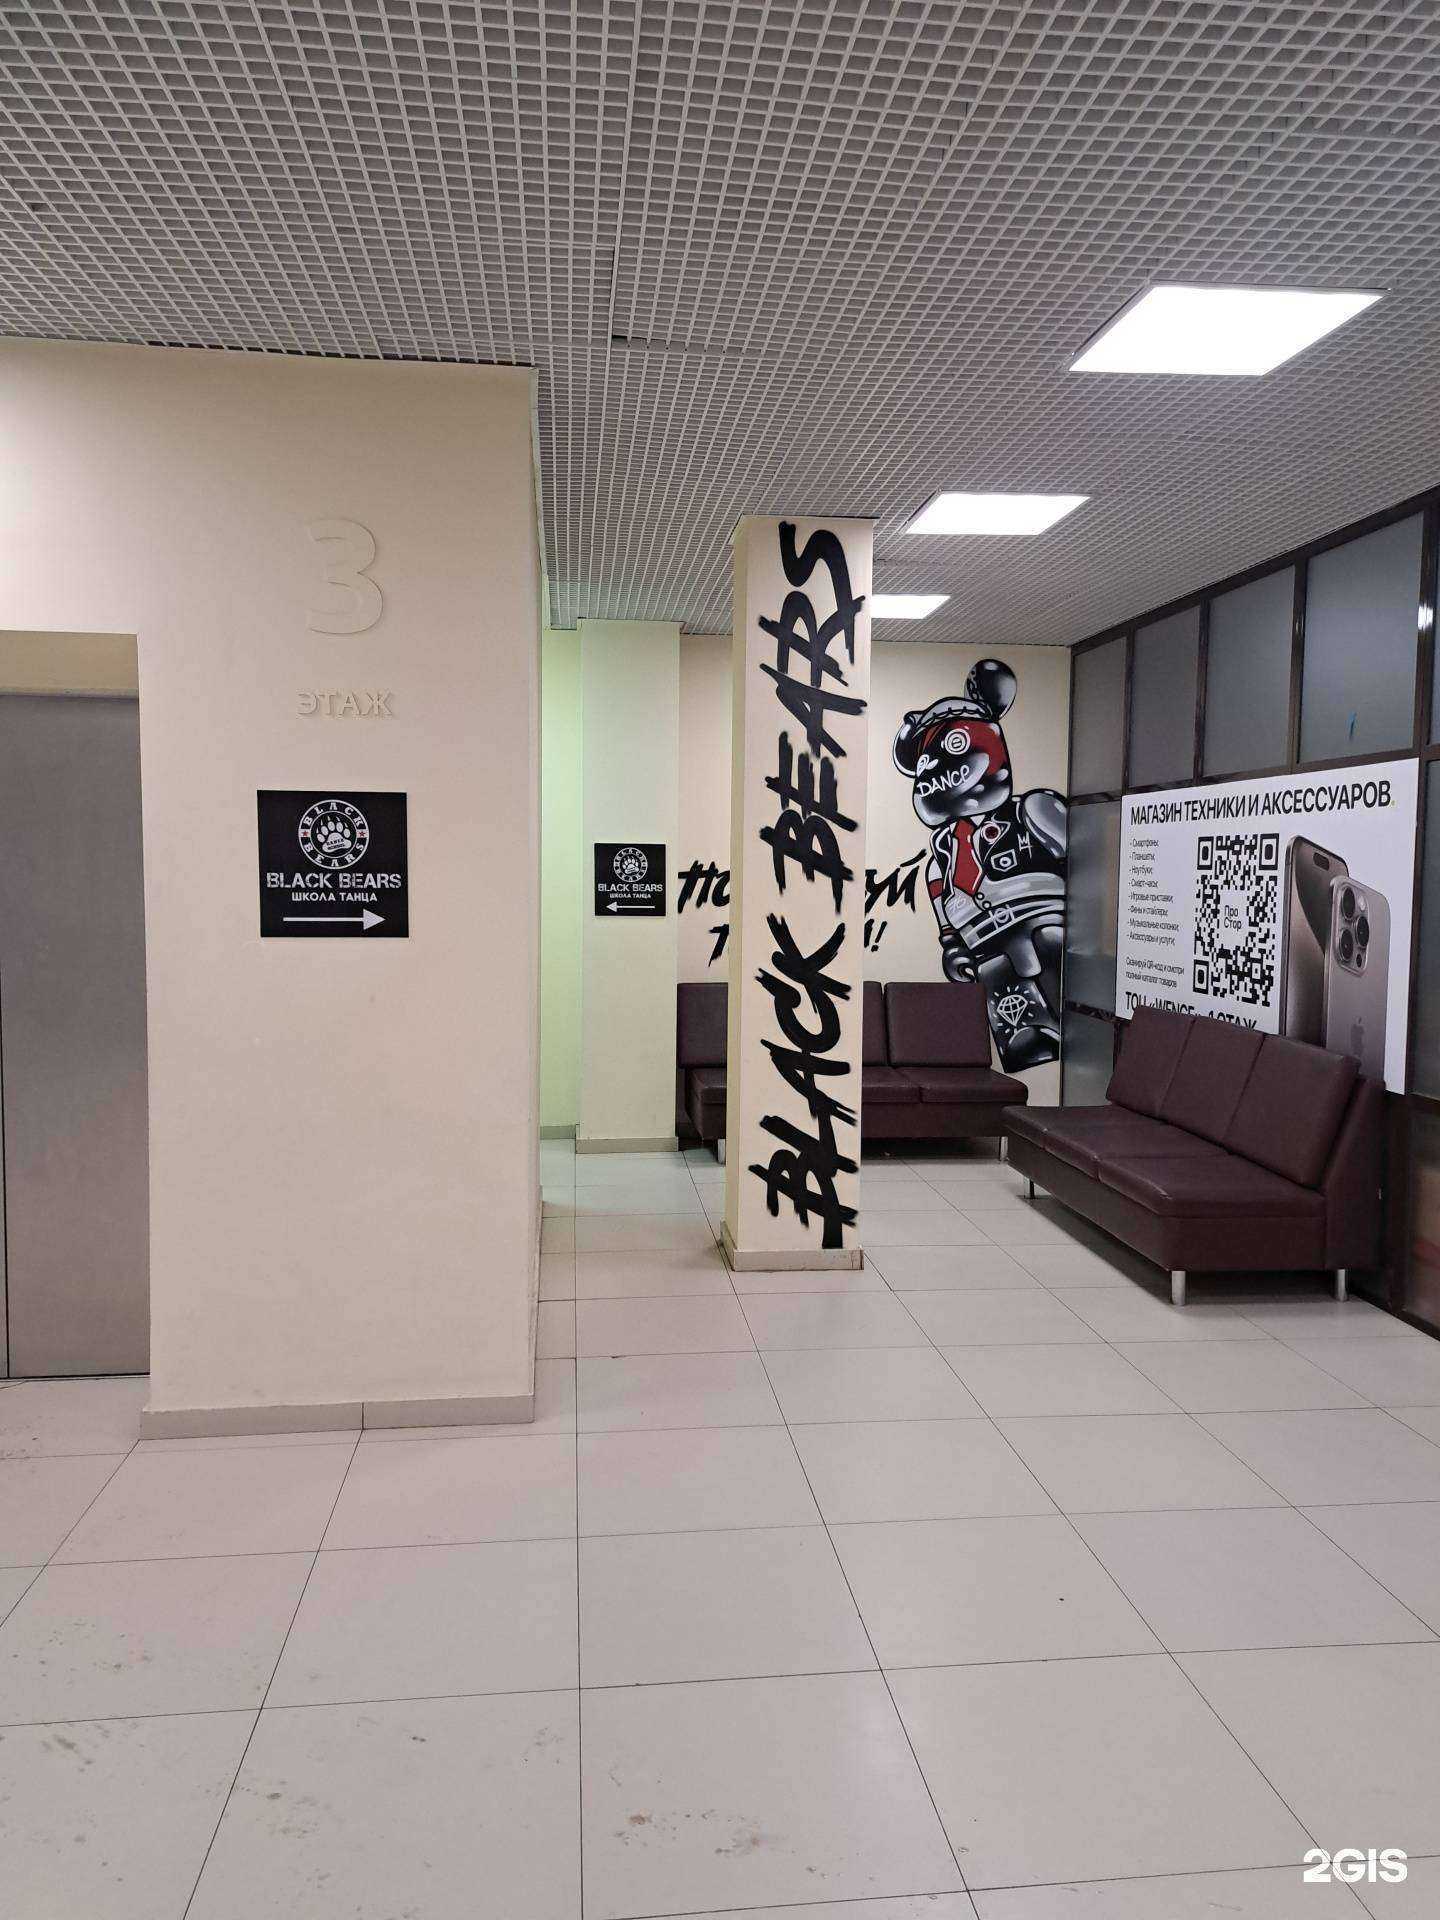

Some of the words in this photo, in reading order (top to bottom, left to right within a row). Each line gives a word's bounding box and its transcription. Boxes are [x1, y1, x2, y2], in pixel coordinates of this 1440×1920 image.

[304, 517, 385, 636] 3
[298, 692, 394, 717] ЭТАЖ
[758, 520, 868, 916] BEARS
[1130, 801, 1182, 826] МАГАЗИН
[1184, 795, 1247, 822] ТЕХНИКИ
[1248, 795, 1260, 818] И
[266, 872, 333, 888] BLACK
[338, 872, 402, 889] BEARS
[597, 883, 630, 892] BLACK
[632, 883, 664, 892] BEARS
[291, 892, 336, 902] ШКОЛА
[339, 892, 378, 902] ТАНЦА
[1224, 904, 1239, 919] Про
[1224, 916, 1242, 931] Стор
[748, 911, 859, 1249] BLACK
